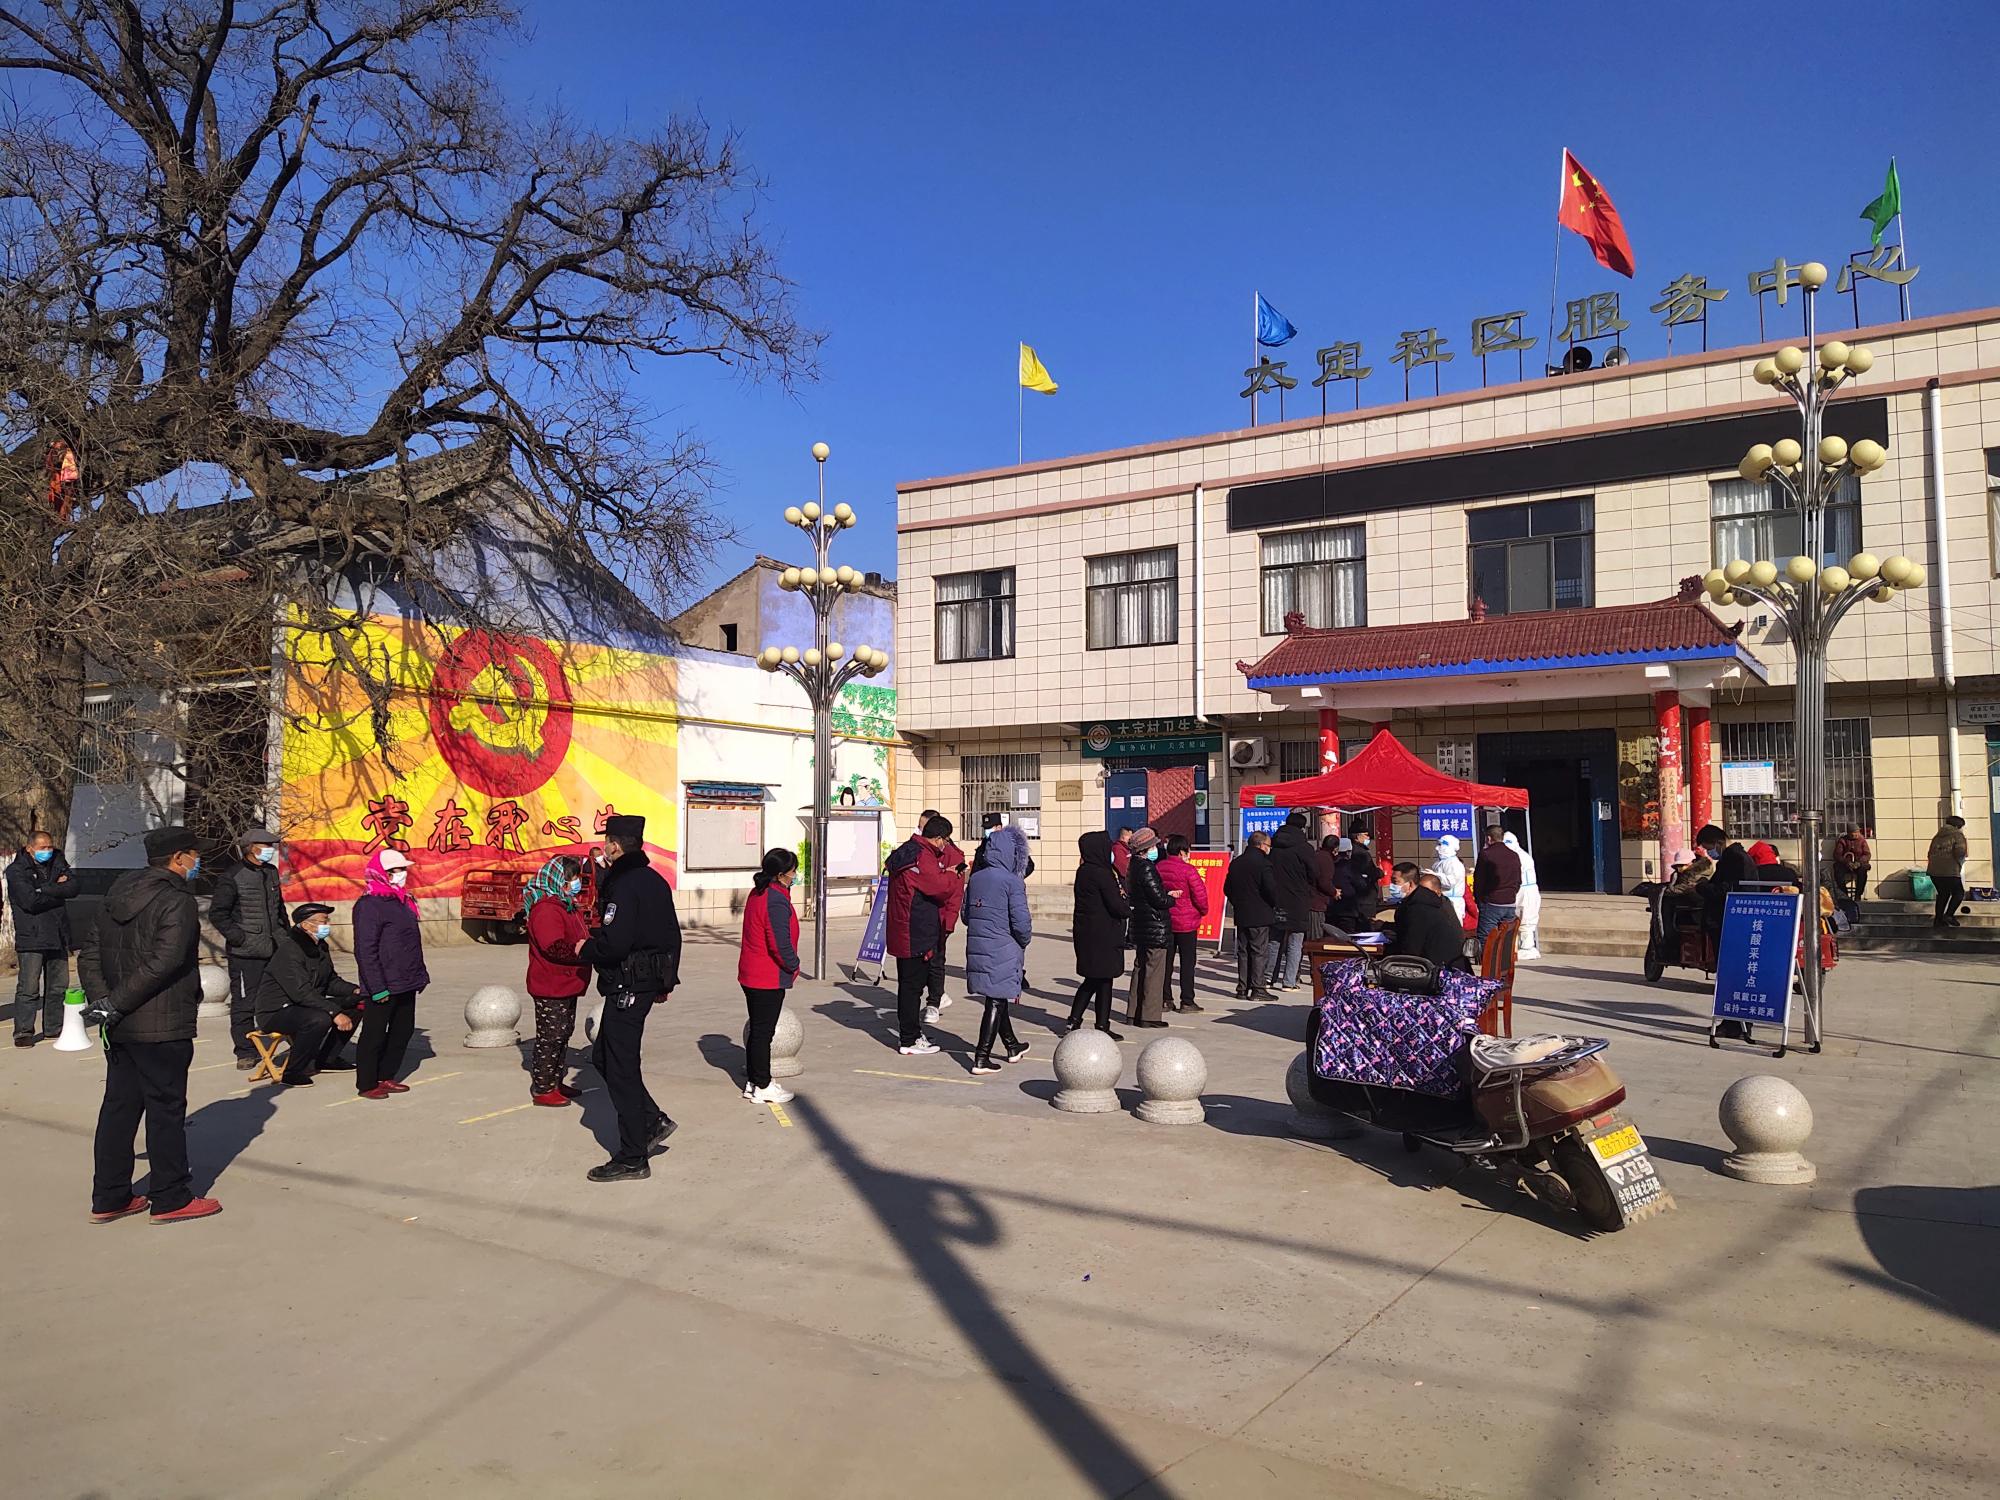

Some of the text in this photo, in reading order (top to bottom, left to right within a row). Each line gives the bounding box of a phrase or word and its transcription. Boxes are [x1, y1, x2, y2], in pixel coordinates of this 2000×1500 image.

[1423, 818, 1469, 832] 核酸采样点
[1745, 919, 1765, 988] 核酸采样点
[1733, 991, 1767, 1003] 佩戴口罩
[1723, 1002, 1775, 1018] 保持一米距离
